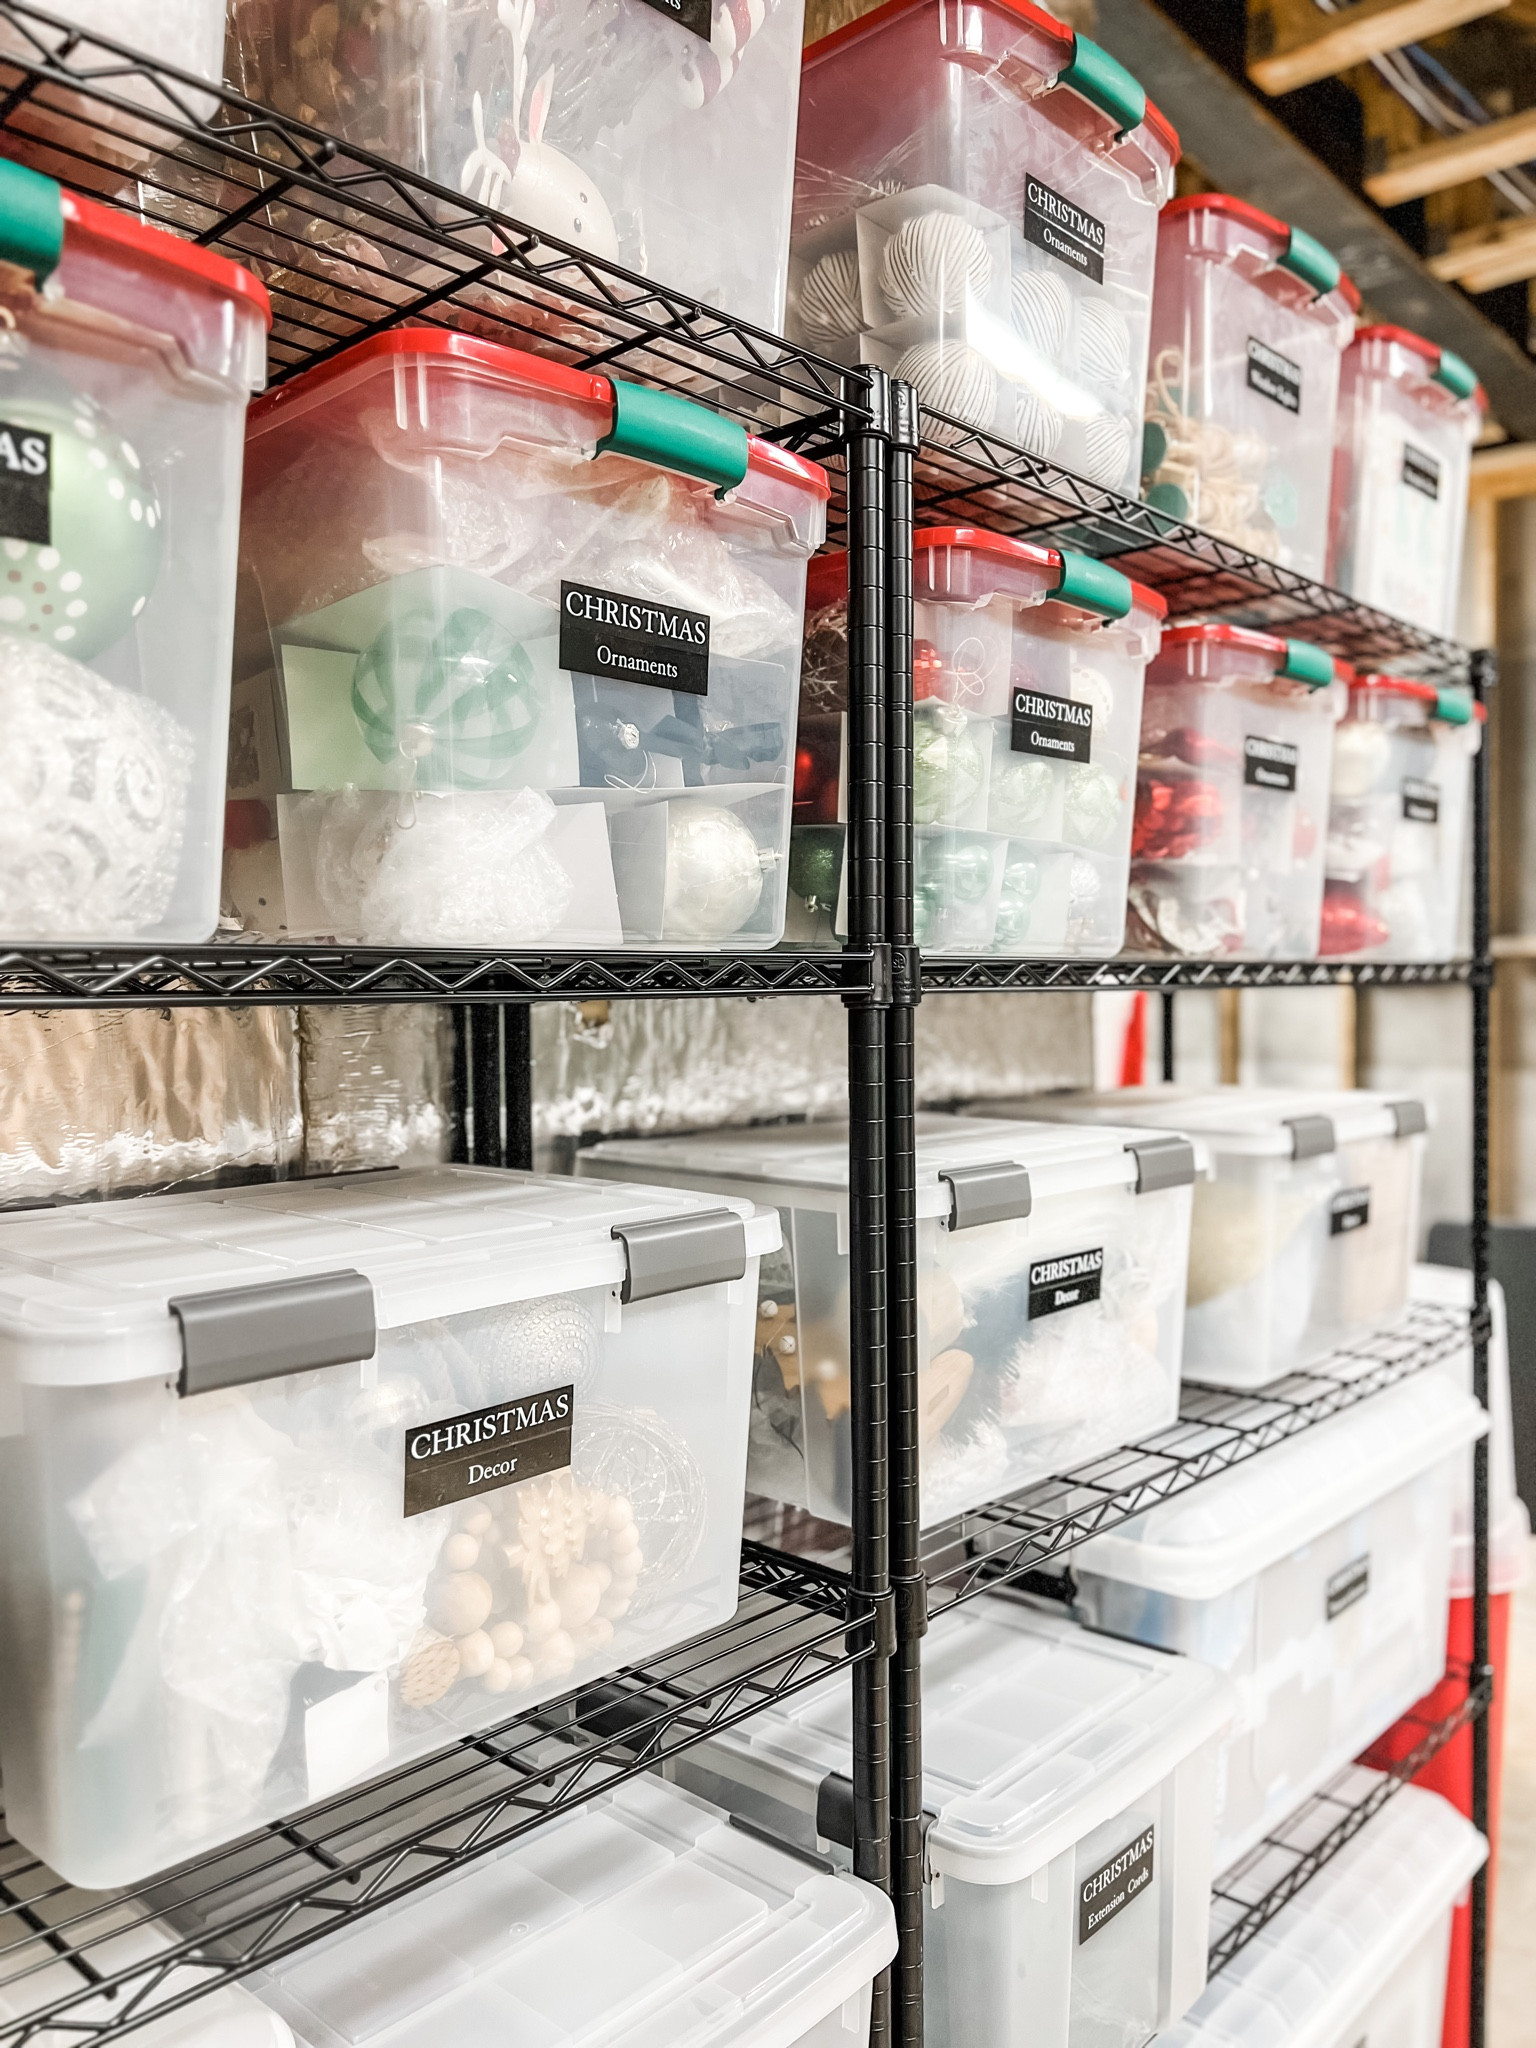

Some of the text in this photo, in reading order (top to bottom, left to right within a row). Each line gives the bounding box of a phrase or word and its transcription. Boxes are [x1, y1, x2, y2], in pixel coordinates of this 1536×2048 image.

[1027, 182, 1103, 245] CHRISTMAS
[1043, 228, 1088, 266] Ornaments
[565, 591, 706, 645] CHRISTMAS
[597, 645, 678, 678] Ornaments
[1015, 693, 1091, 727] CHRISTMAS
[1030, 730, 1075, 752] Ornaments
[1031, 1250, 1102, 1285] CHRISTMAS
[410, 1394, 569, 1460] CHRISTMAS
[468, 1458, 518, 1485] Decor
[1083, 1830, 1153, 1903] CHRISTMAS
[1087, 1866, 1149, 1930] Extension Cords
